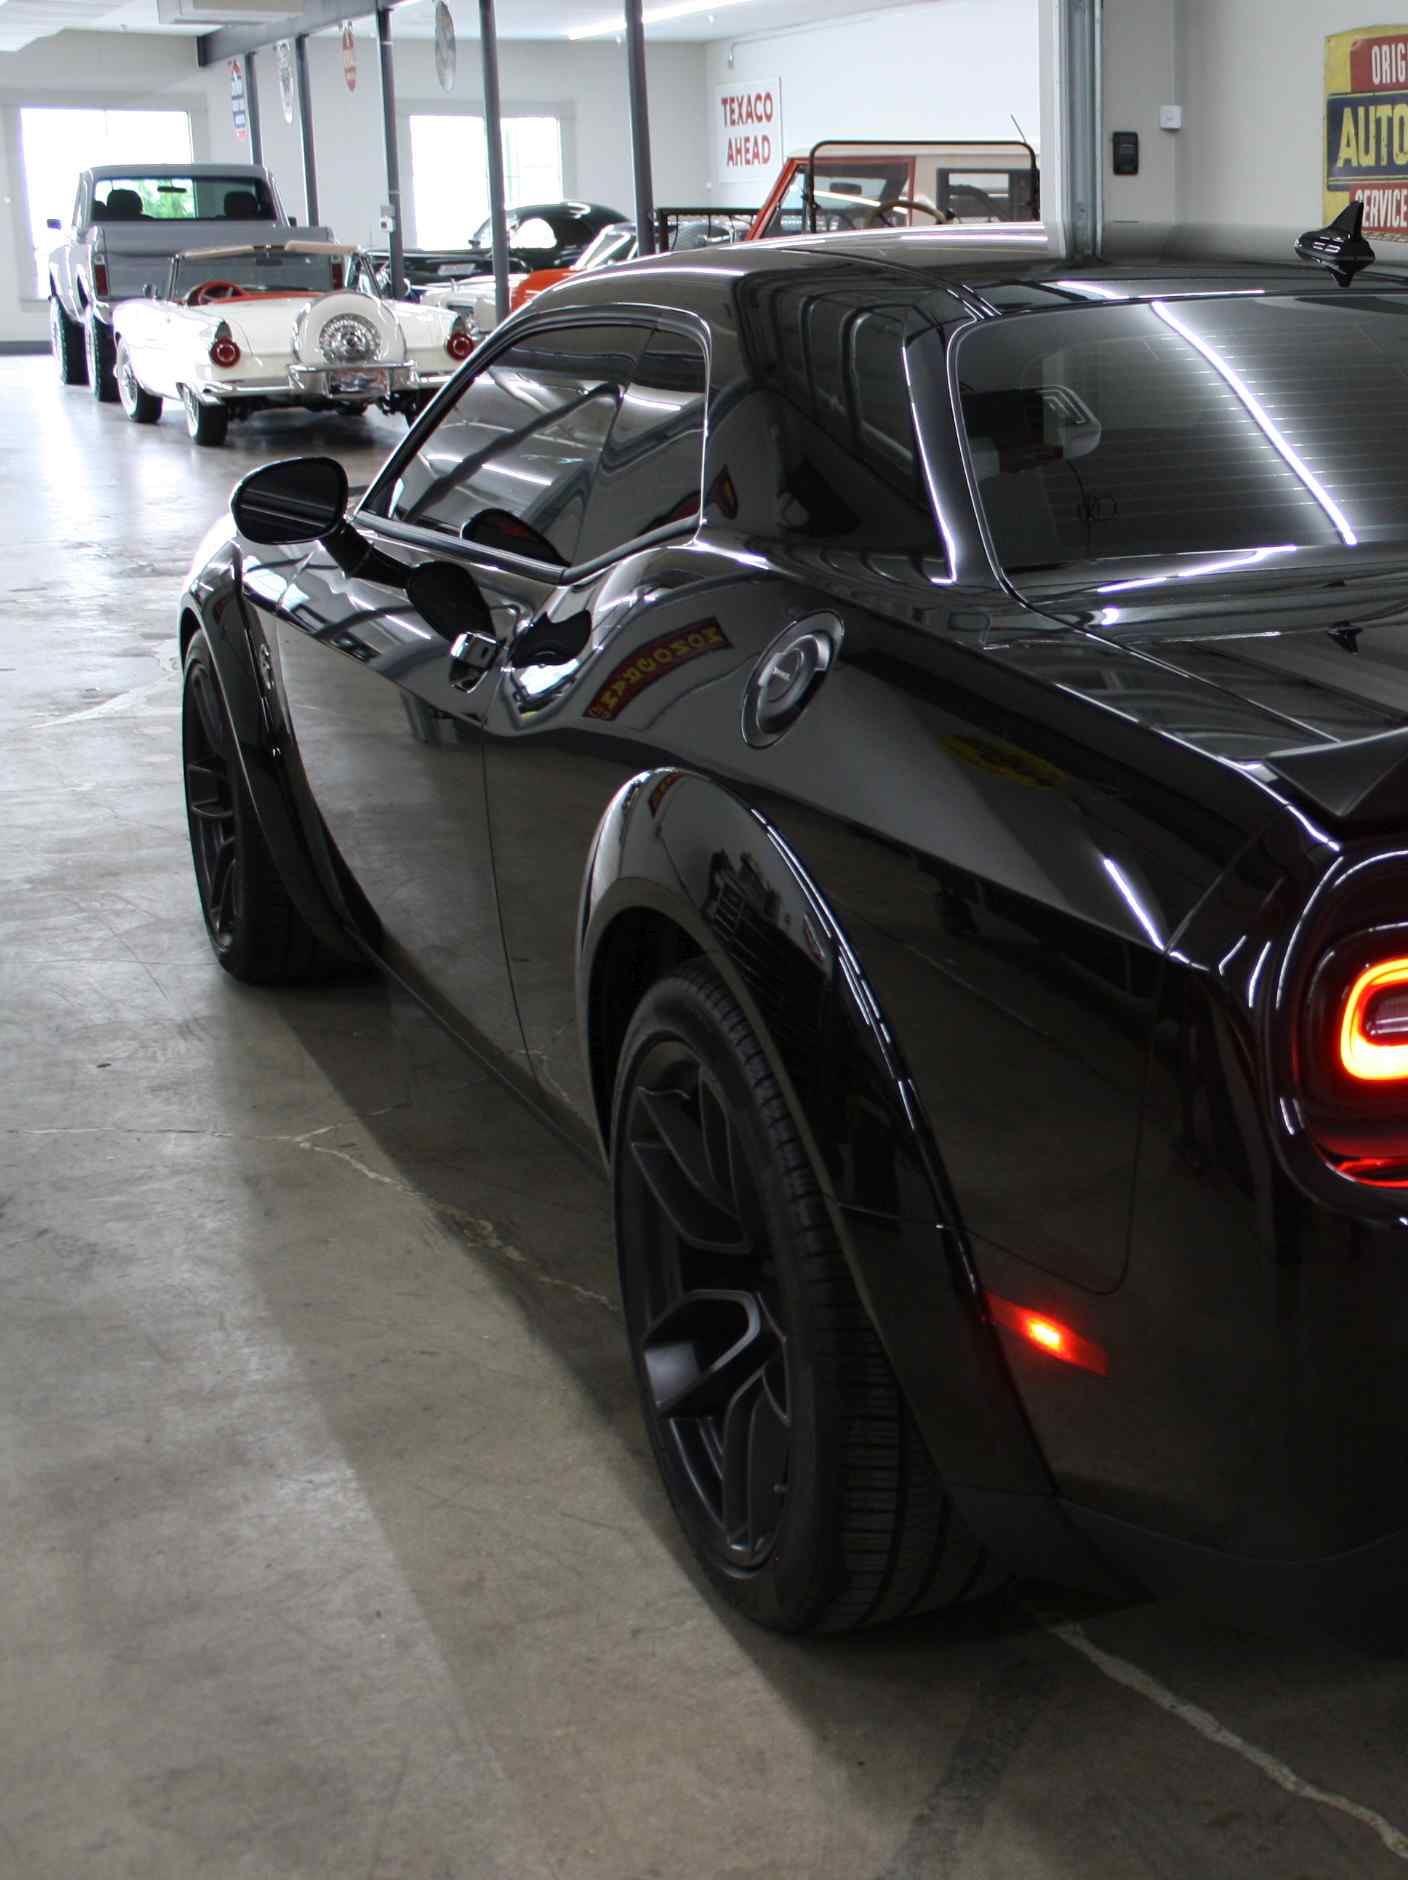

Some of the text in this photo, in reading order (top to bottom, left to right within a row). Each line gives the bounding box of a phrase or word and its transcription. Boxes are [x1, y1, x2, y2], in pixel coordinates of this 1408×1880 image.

[721, 91, 773, 128] TEXACO
[727, 135, 770, 167] AHEAD
[1355, 188, 1408, 227] SERVICE
